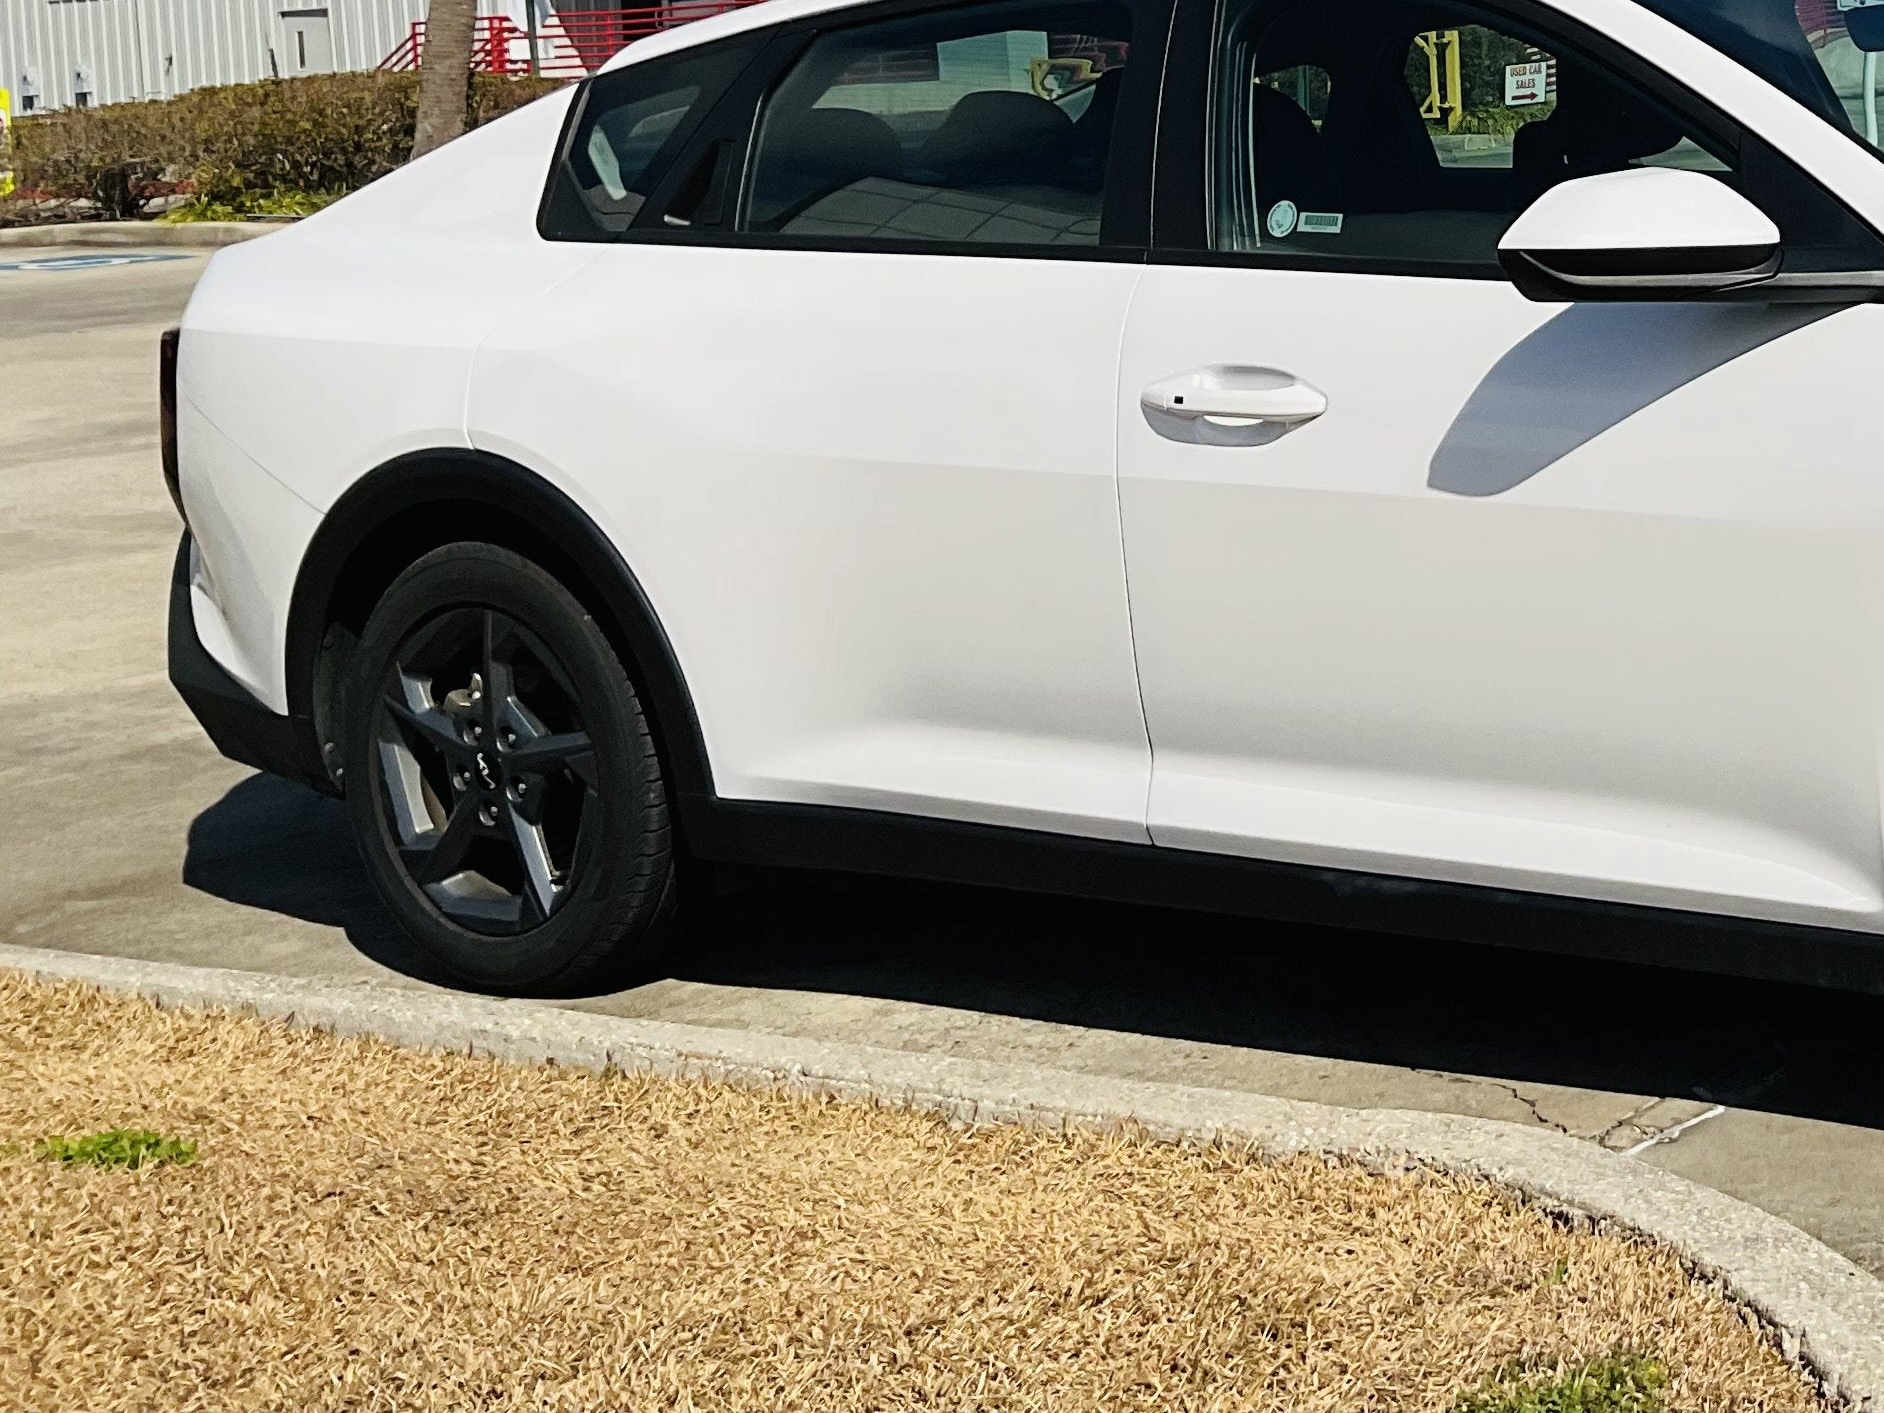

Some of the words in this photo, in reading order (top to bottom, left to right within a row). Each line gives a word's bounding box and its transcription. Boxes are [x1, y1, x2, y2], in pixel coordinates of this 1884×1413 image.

[1510, 65, 1528, 77] USED
[1528, 63, 1543, 75] CAR
[1515, 78, 1536, 89] SALES
